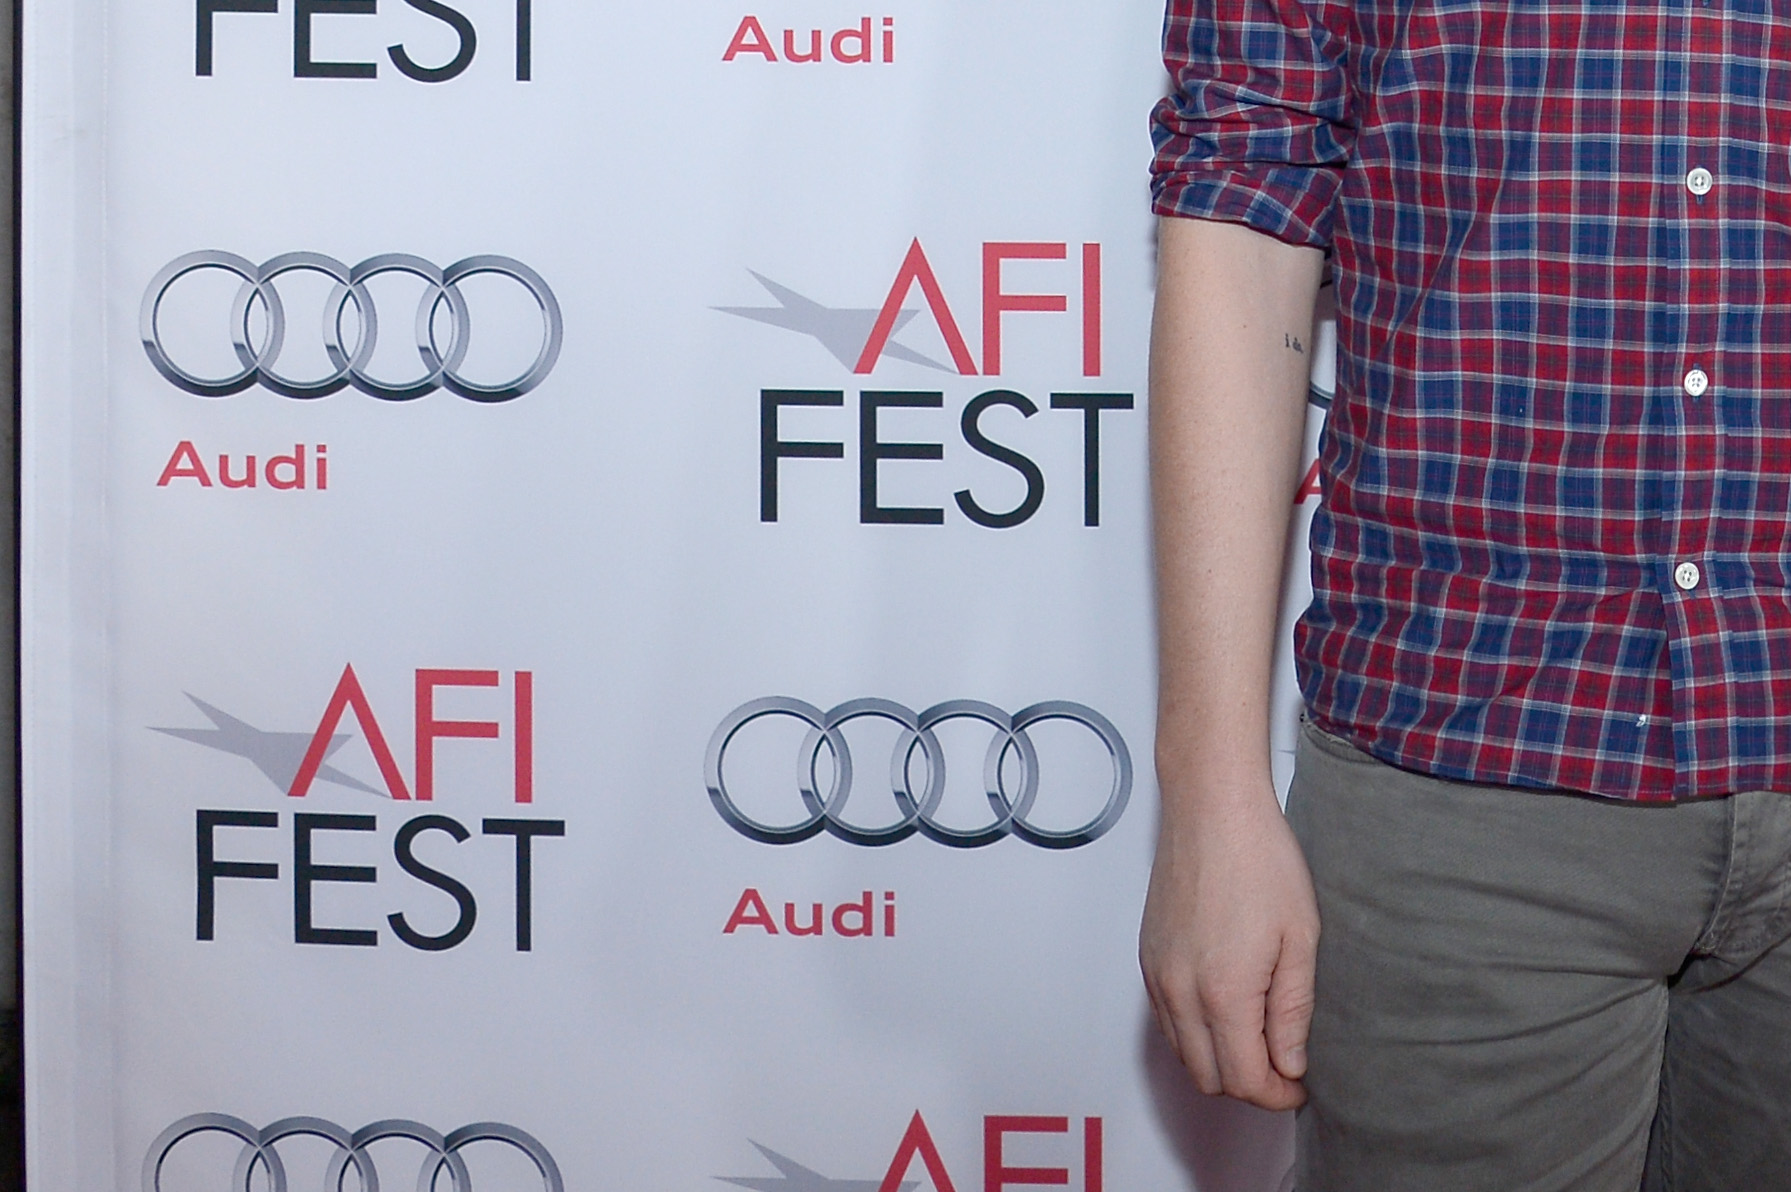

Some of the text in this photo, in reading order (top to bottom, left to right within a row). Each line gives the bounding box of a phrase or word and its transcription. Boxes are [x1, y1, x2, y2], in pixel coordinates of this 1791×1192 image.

[724, 16, 893, 63] Audi
[855, 240, 1101, 376] AFI
[159, 441, 327, 489] Audi
[761, 388, 1133, 528] FEST
[290, 666, 532, 803] AFI
[197, 815, 565, 951] FEST
[725, 889, 894, 936] Audi
[880, 1113, 1102, 1192] AFI
